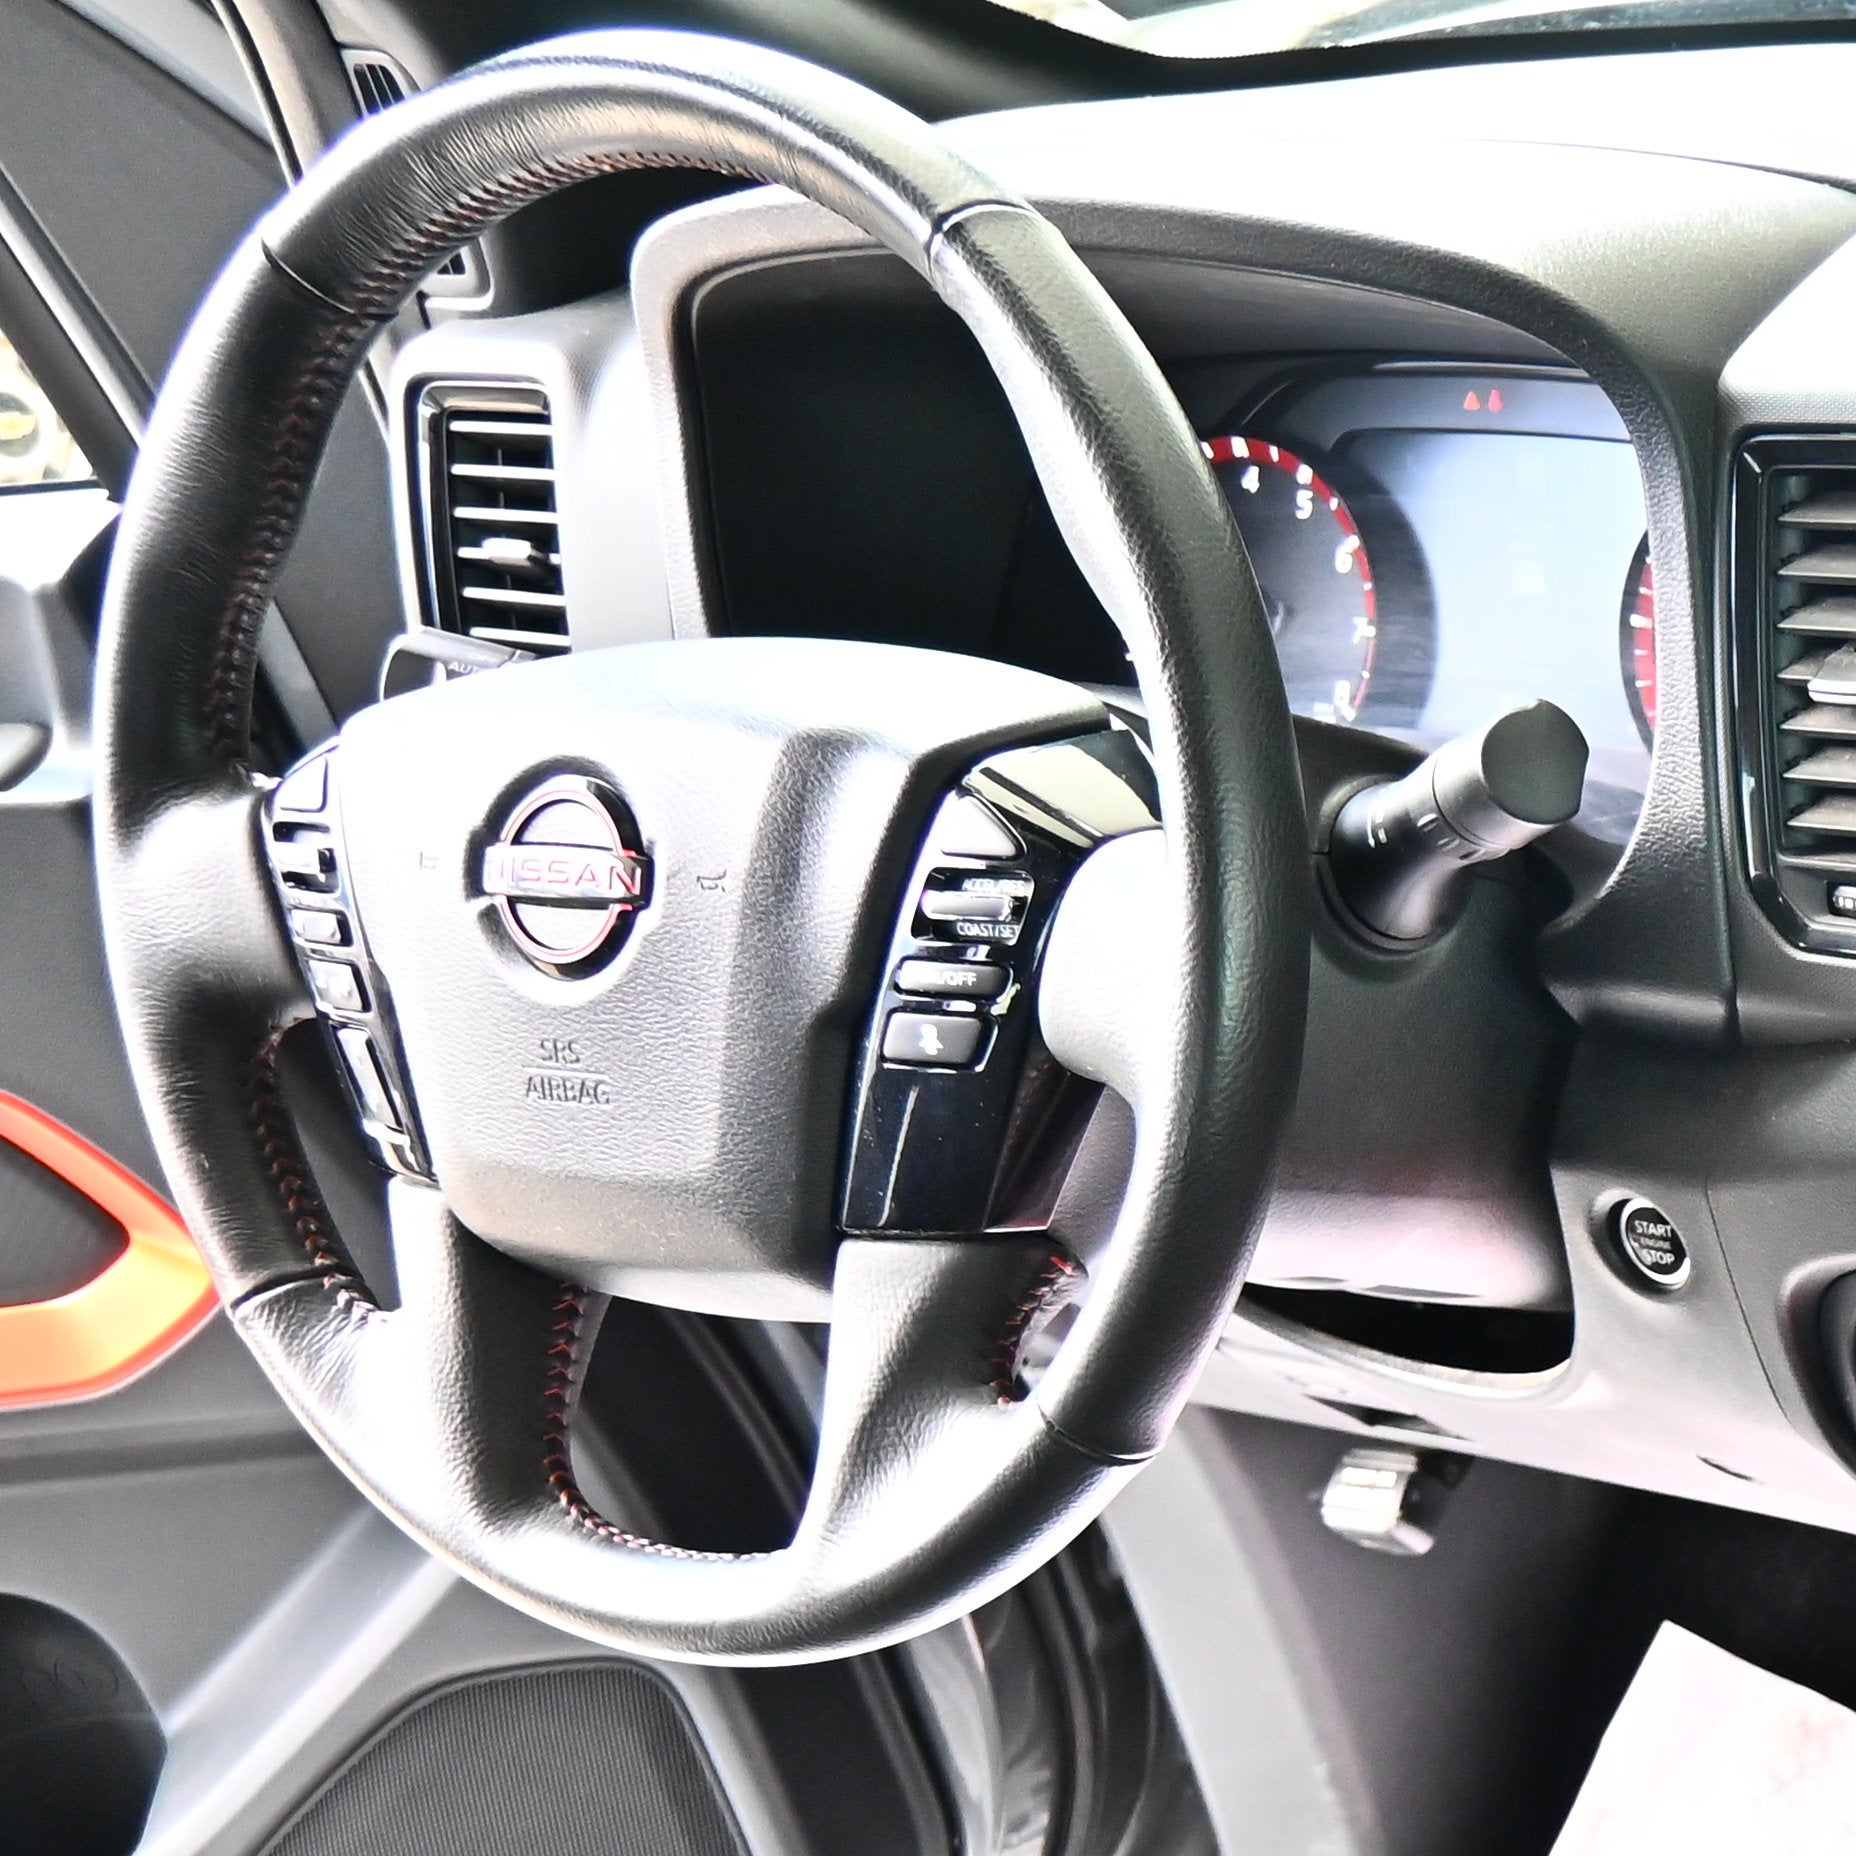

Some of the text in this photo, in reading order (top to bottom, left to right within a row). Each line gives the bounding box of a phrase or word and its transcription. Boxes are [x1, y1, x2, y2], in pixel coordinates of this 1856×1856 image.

[1241, 465, 1260, 494] 4
[1295, 488, 1313, 520] 5
[1335, 543, 1353, 574] 6
[541, 1039, 581, 1064] SRS
[526, 1076, 610, 1105] AIRBAG
[1634, 1220, 1672, 1238] START
[1641, 1249, 1675, 1266] STOP
